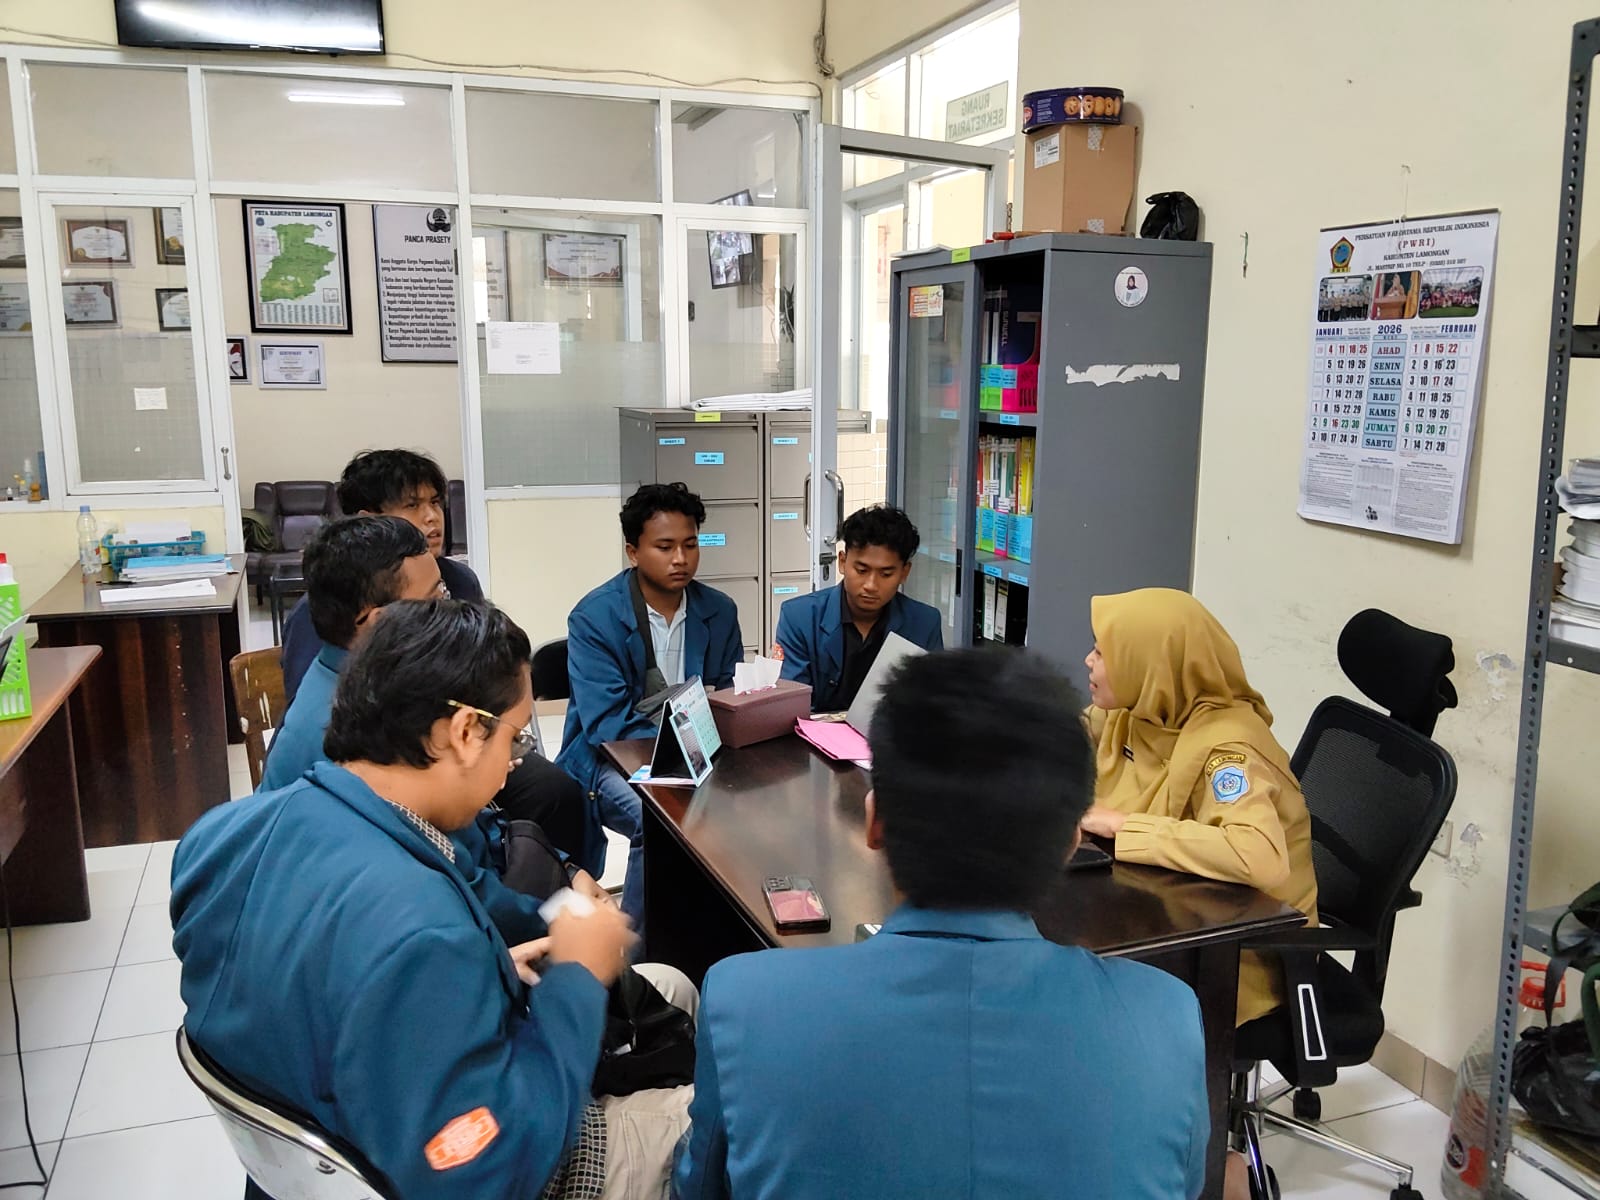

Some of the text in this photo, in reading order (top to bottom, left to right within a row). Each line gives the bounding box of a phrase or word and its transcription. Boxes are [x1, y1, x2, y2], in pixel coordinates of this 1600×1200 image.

[1355, 231, 1386, 241] PERSATUAN
[1422, 224, 1453, 234] REPUBLIK
[1454, 220, 1490, 231] INDONESIA
[404, 235, 424, 243] PANCA
[1415, 249, 1450, 259] LAMONGAN
[1315, 327, 1343, 336] JANUARI
[1377, 324, 1402, 334] 2026
[1440, 323, 1477, 333] FEBRUARI
[1328, 344, 1333, 353] 4
[1339, 344, 1345, 354] 11
[1349, 344, 1356, 354] 18
[1359, 344, 1367, 354] 25
[1377, 346, 1401, 355] AHAD
[1414, 343, 1418, 353] 1
[1425, 343, 1430, 353] 8
[1436, 343, 1444, 353] 15
[1448, 343, 1458, 353] 22
[1327, 359, 1456, 371] 5 12 19 26 SENIN 2 9 16 23
[1326, 374, 1454, 386] 6 13 20 27 SELASA 3 10 17 24
[1325, 389, 1452, 403] 7 14 21 28 RABU 4 11 18 25
[1314, 403, 1450, 420] 1 8 15 22 29 KAMIS 5 12 19 26
[1312, 417, 1317, 427] 2
[1323, 417, 1328, 427] 9
[1332, 418, 1339, 428] 16
[1341, 419, 1349, 429] 23
[1351, 419, 1360, 429] 30
[1404, 422, 1410, 433] 6
[1415, 423, 1423, 433] 13
[1426, 424, 1435, 434] 20
[1438, 425, 1447, 435] 27
[1311, 431, 1446, 452] 3 10 17 24 31 SABTU 7 14 21 28
